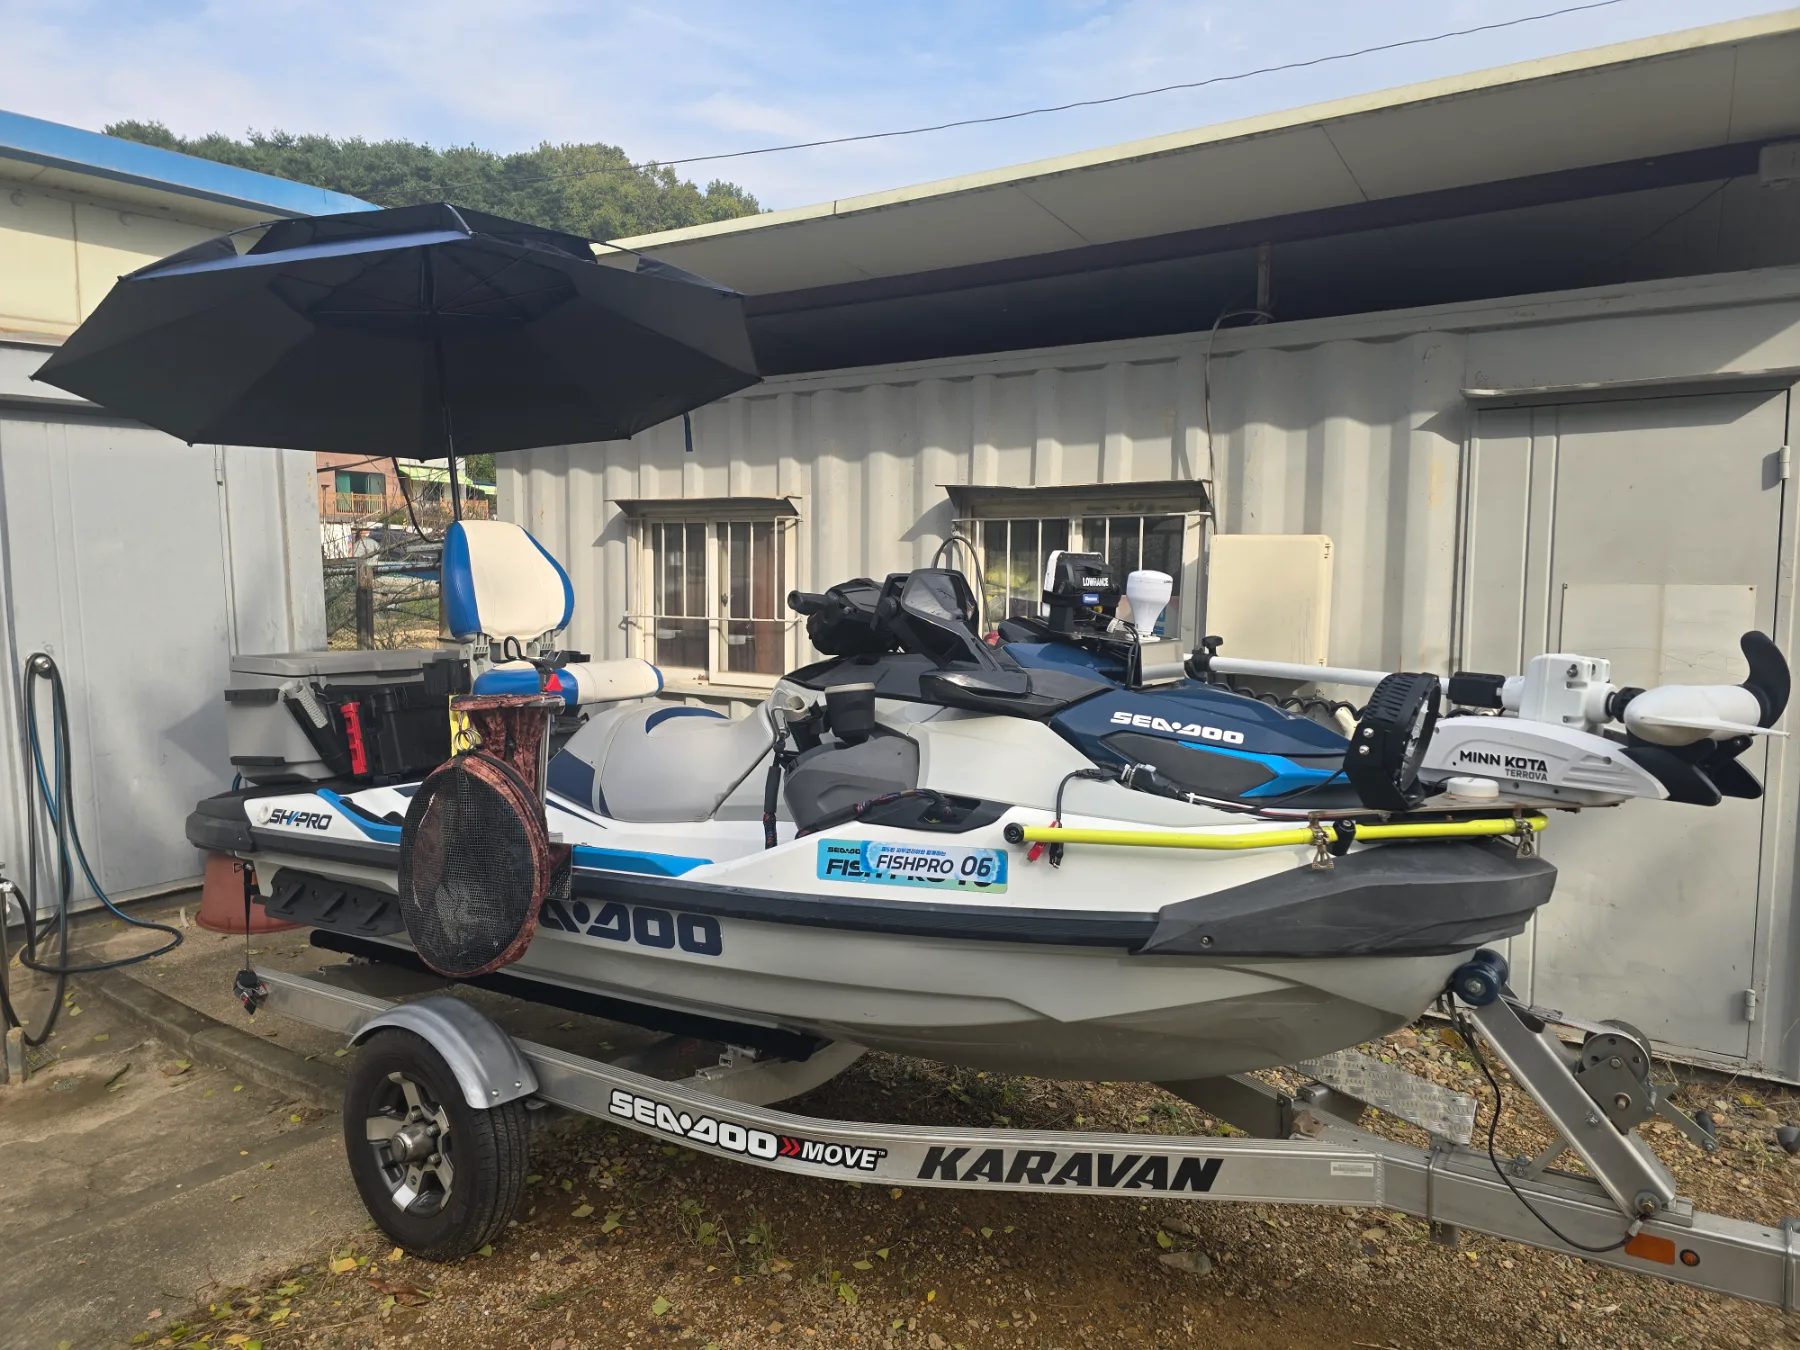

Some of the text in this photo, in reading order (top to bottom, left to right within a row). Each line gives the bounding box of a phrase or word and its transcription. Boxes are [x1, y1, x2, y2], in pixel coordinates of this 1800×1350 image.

[1082, 576, 1109, 587] LOWRANCE
[1460, 750, 1548, 773] MINN KOTA
[1504, 768, 1548, 782] TERROVA
[876, 854, 954, 875] FISHPRO
[960, 855, 993, 878] 06
[917, 1146, 1225, 1192] KARAVAN
